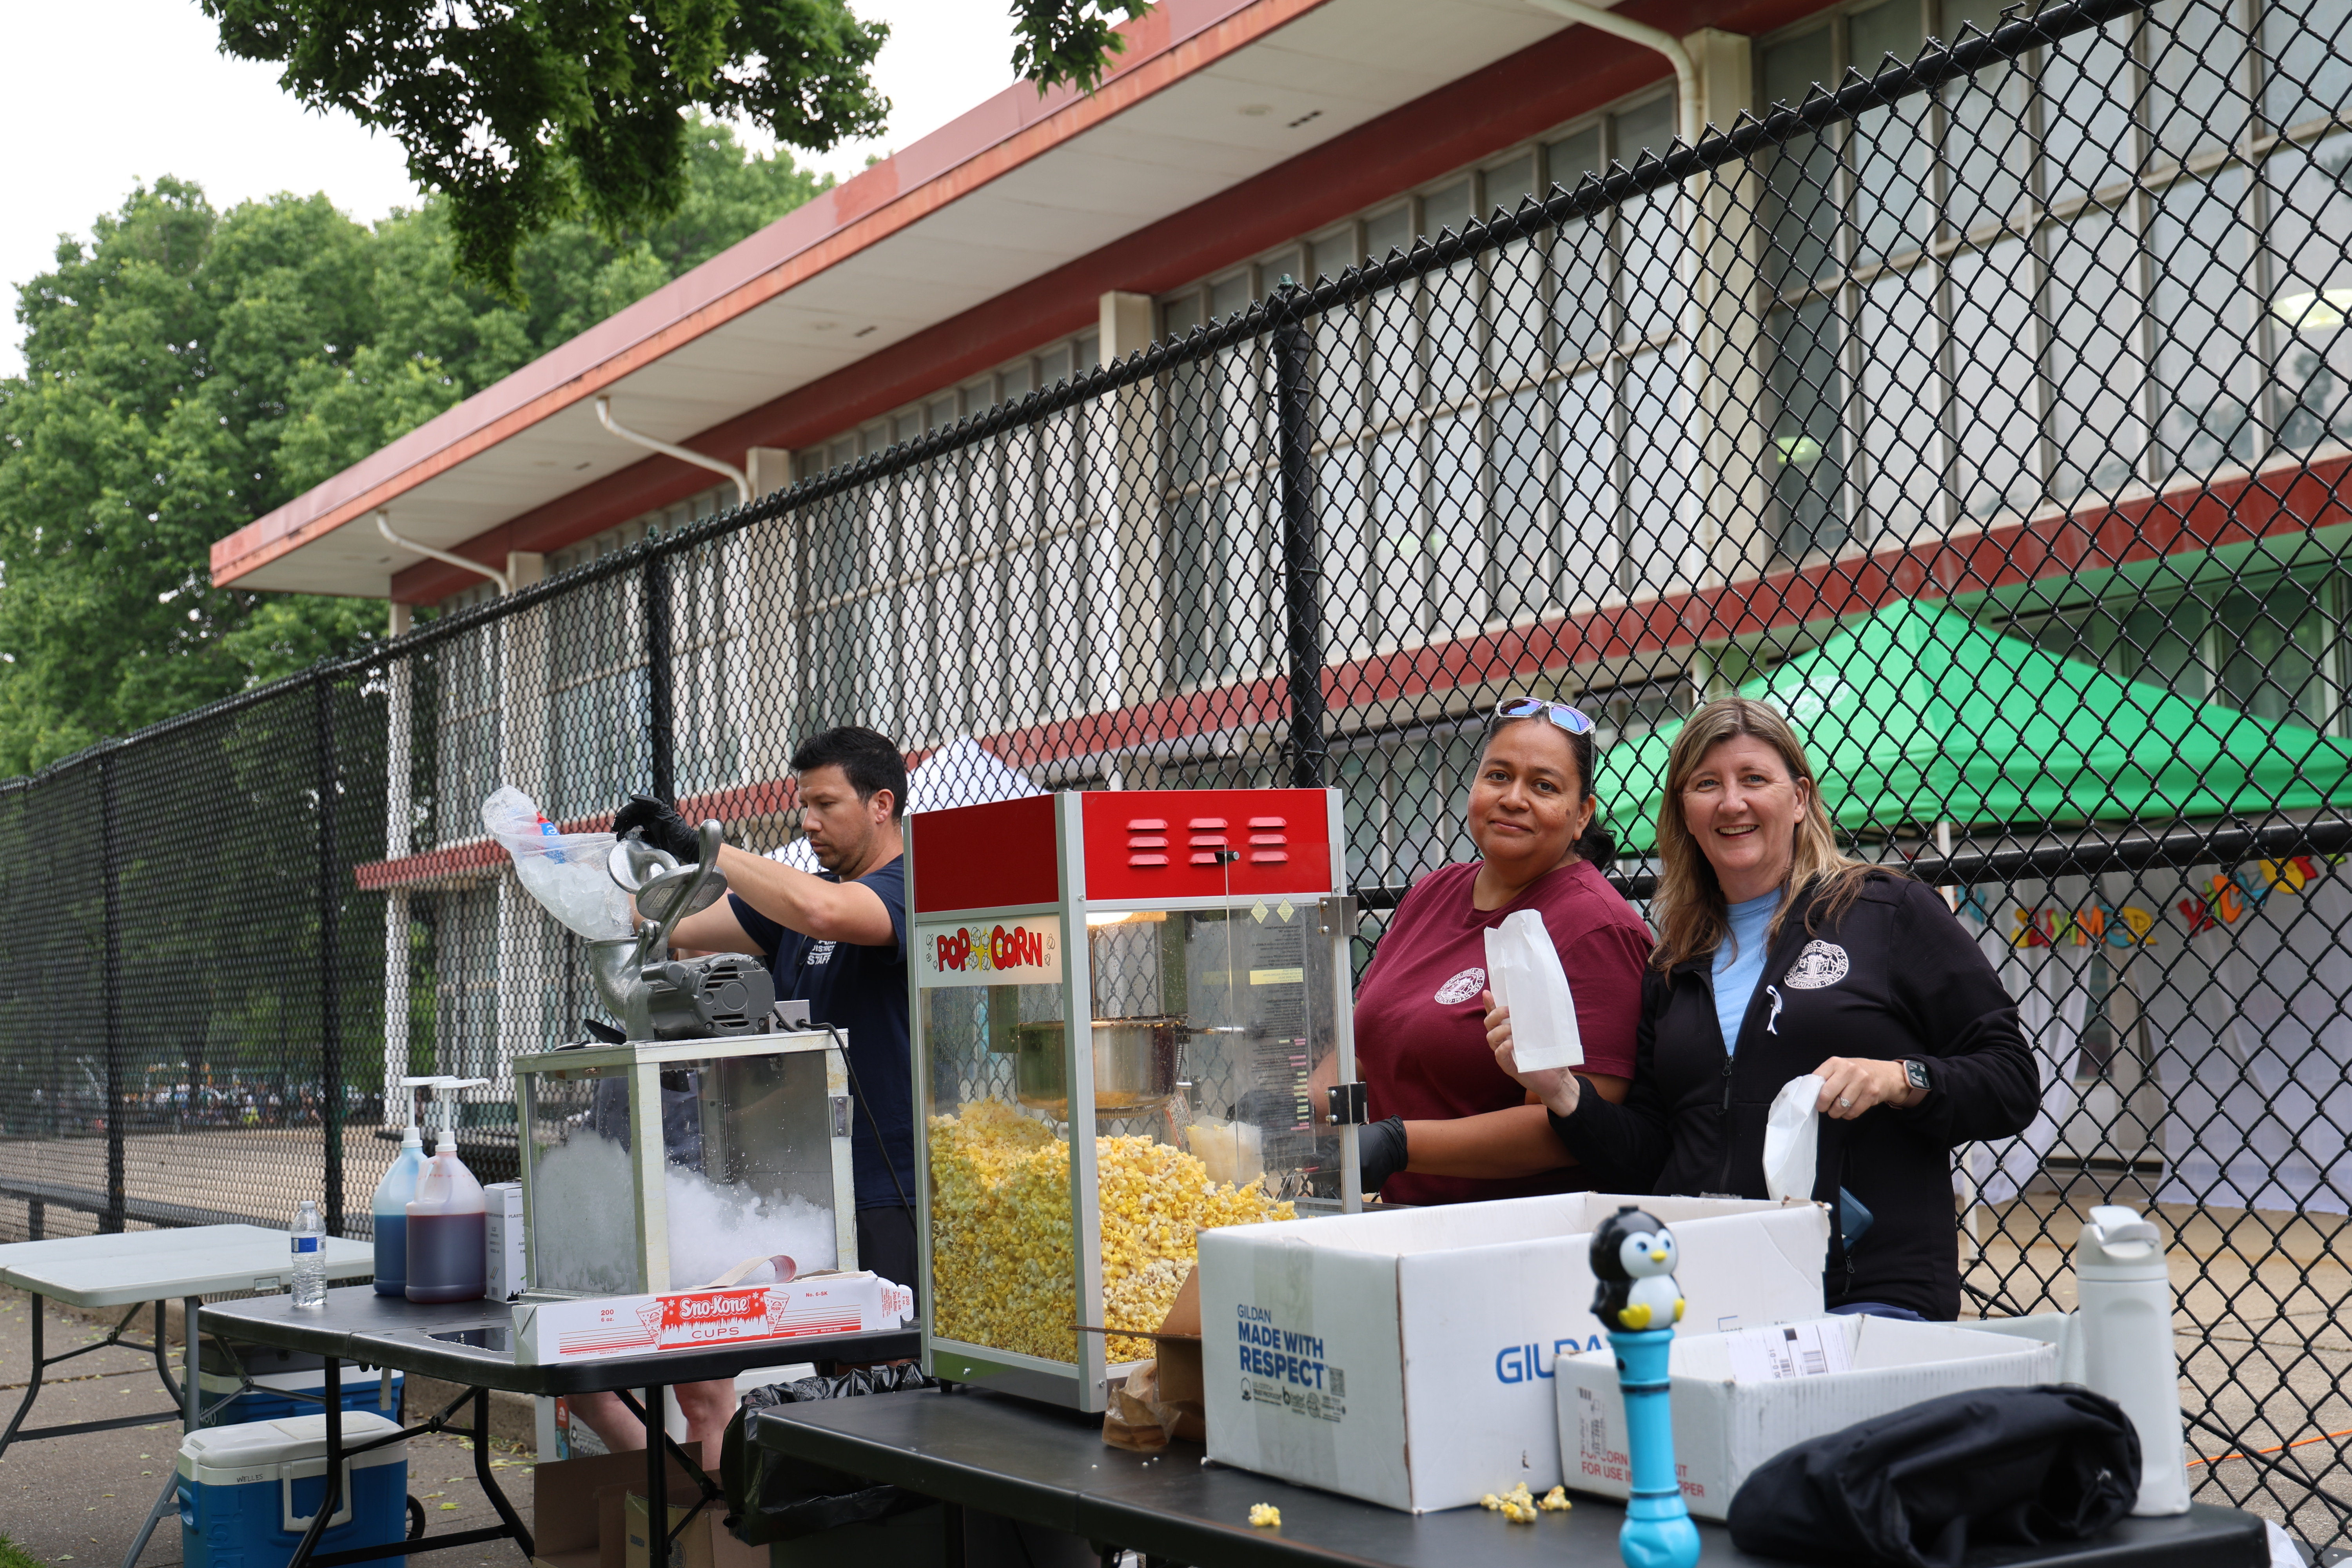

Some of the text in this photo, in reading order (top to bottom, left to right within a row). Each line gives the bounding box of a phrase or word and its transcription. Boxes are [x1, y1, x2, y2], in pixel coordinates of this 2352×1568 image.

[2010, 904, 2158, 947] SUMMER
[936, 925, 1043, 972] POP CORN
[1820, 942, 1844, 958] DISTRICT
[807, 954, 831, 965] STAFF
[1472, 982, 1482, 993] SEAL
[1787, 973, 1841, 987] ORGANIZED 1934
[1455, 994, 1471, 1002] 1934
[681, 1295, 750, 1318] Sno-Kone
[1238, 1304, 1271, 1324] GILDAN
[691, 1327, 739, 1339] CUPS
[1238, 1321, 1323, 1359] MADE WITH
[1239, 1344, 1324, 1390] RESPECT
[1496, 1334, 1602, 1384] GIL
[237, 1473, 263, 1483] WELLES
[1581, 1461, 1601, 1476] FOR
[1603, 1465, 1623, 1481] USE
[1677, 1480, 1705, 1498] PER
